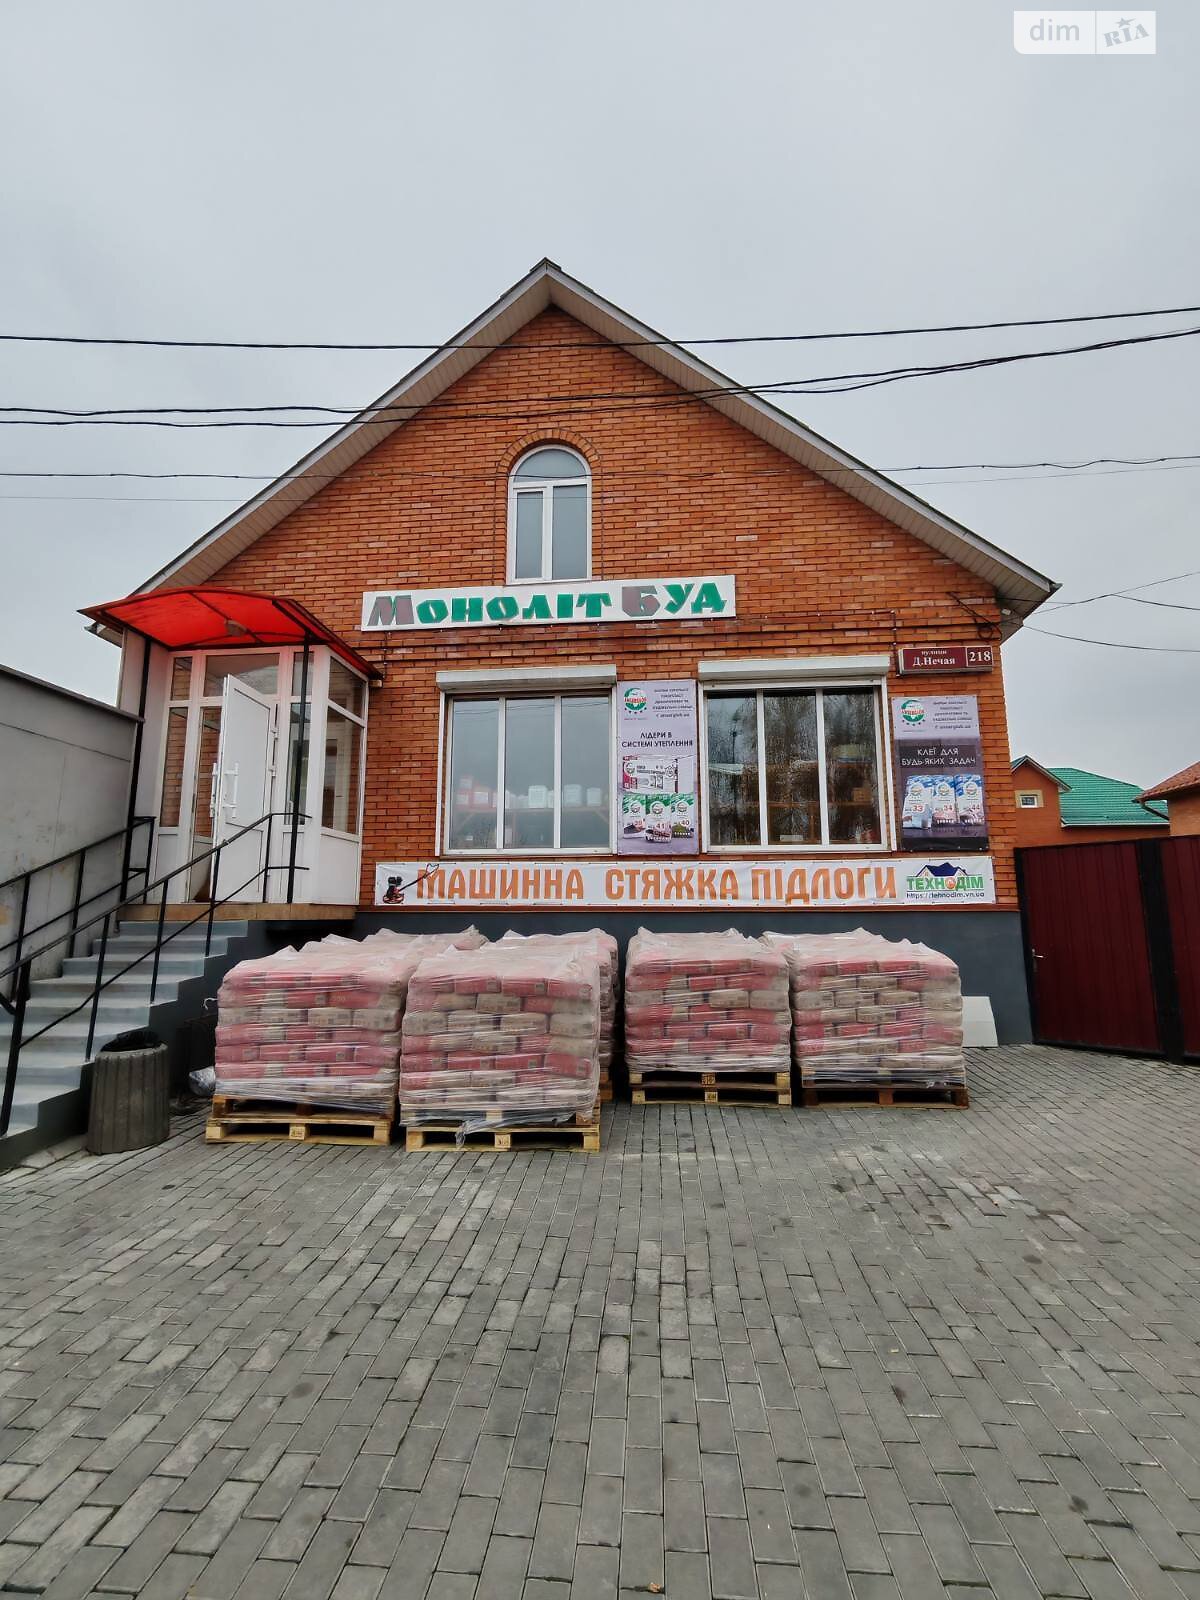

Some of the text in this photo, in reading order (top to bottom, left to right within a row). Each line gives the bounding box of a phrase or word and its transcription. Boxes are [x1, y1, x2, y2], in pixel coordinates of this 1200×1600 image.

[969, 650, 991, 662] 218
[912, 656, 956, 667] Д.Нечая
[654, 740, 693, 748] УТЕПЛЕННЯ
[940, 748, 959, 756] ДЛЯ
[901, 757, 976, 766] БУДЬ-ЯКИХ ЗАДАЧ
[416, 866, 897, 905] МАШИННА СТЯЖКА ПІДЛОГИ
